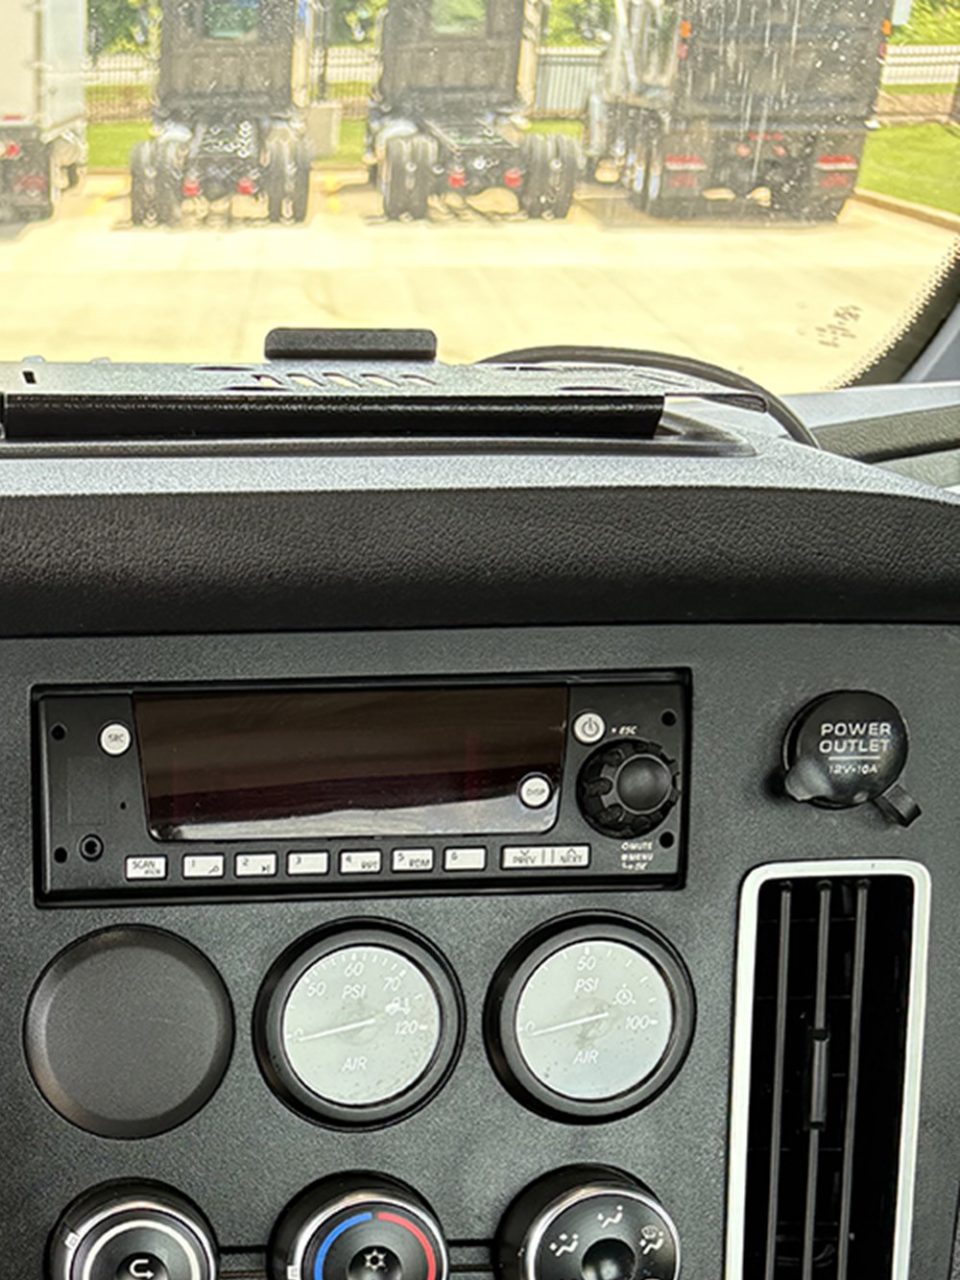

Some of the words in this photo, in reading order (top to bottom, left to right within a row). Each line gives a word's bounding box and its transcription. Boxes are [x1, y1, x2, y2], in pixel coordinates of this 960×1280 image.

[820, 723, 891, 736] POWER
[819, 739, 890, 753] OUTLET
[132, 860, 155, 869] SCAN
[344, 961, 364, 977] 60
[576, 956, 596, 971] 50
[306, 981, 326, 998] 50
[342, 984, 366, 999] PSI
[383, 977, 401, 991] 70
[574, 977, 599, 993] PSI
[395, 1020, 418, 1035] 120
[626, 1015, 649, 1030] 100
[342, 1056, 368, 1071] AIR
[573, 1050, 599, 1065] AIR
